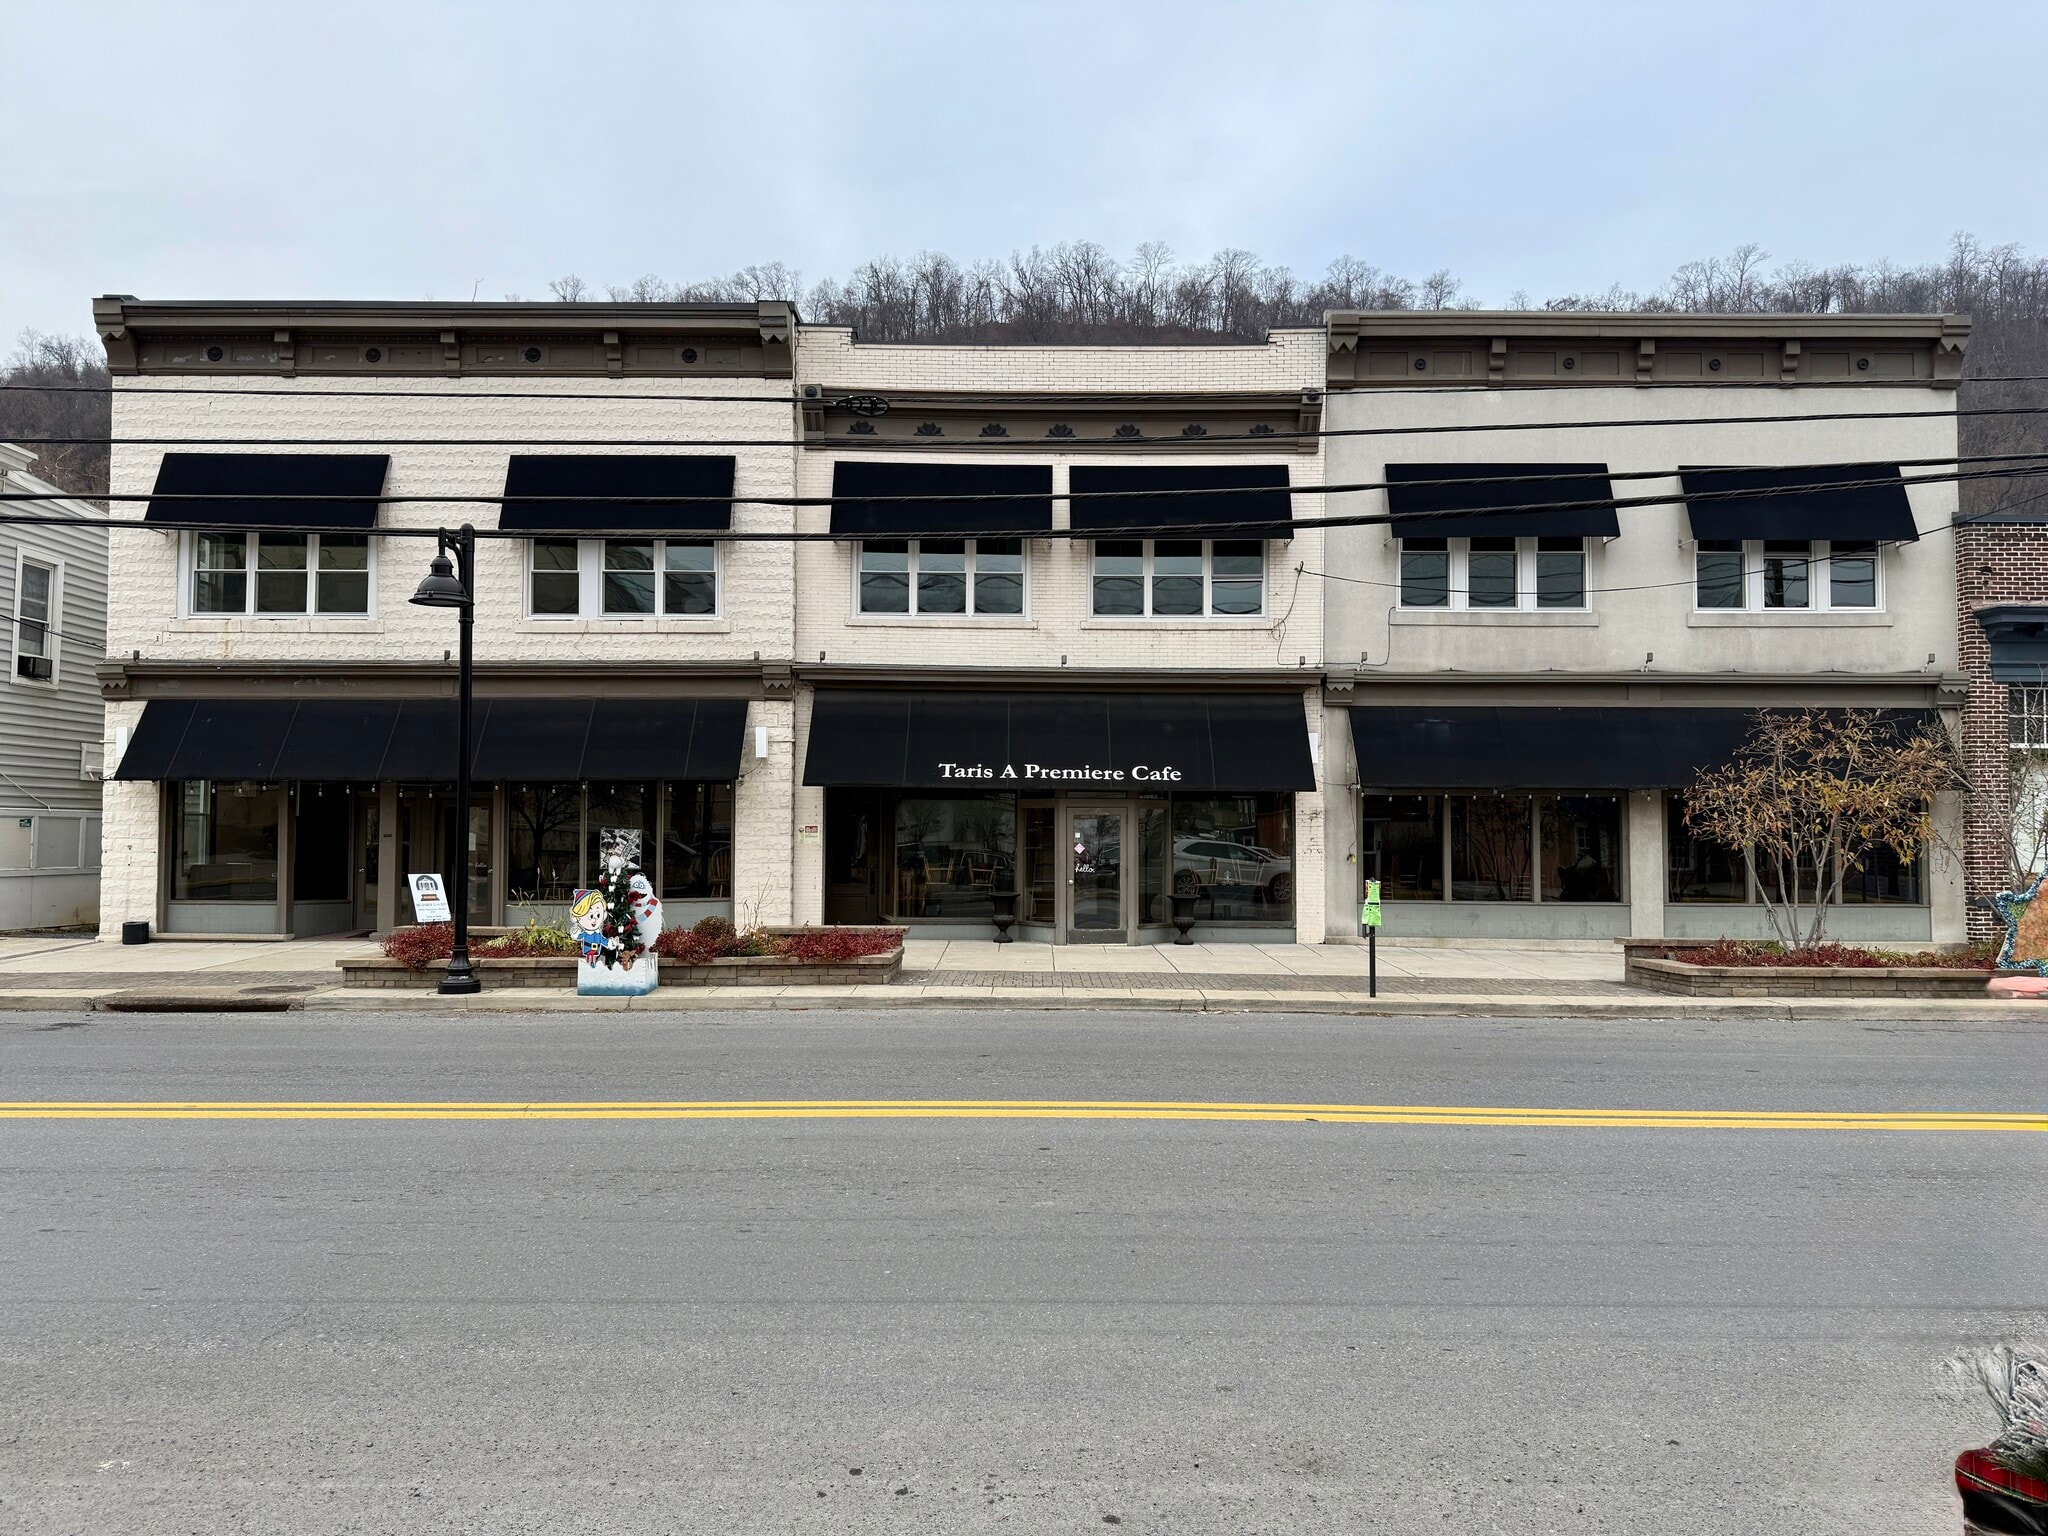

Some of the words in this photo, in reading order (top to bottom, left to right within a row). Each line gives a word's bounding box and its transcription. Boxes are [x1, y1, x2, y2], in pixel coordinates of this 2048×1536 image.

[938, 763, 994, 779] Taris
[999, 764, 1019, 778] A
[1024, 764, 1125, 781] Premiere
[1131, 765, 1182, 781] Cafe
